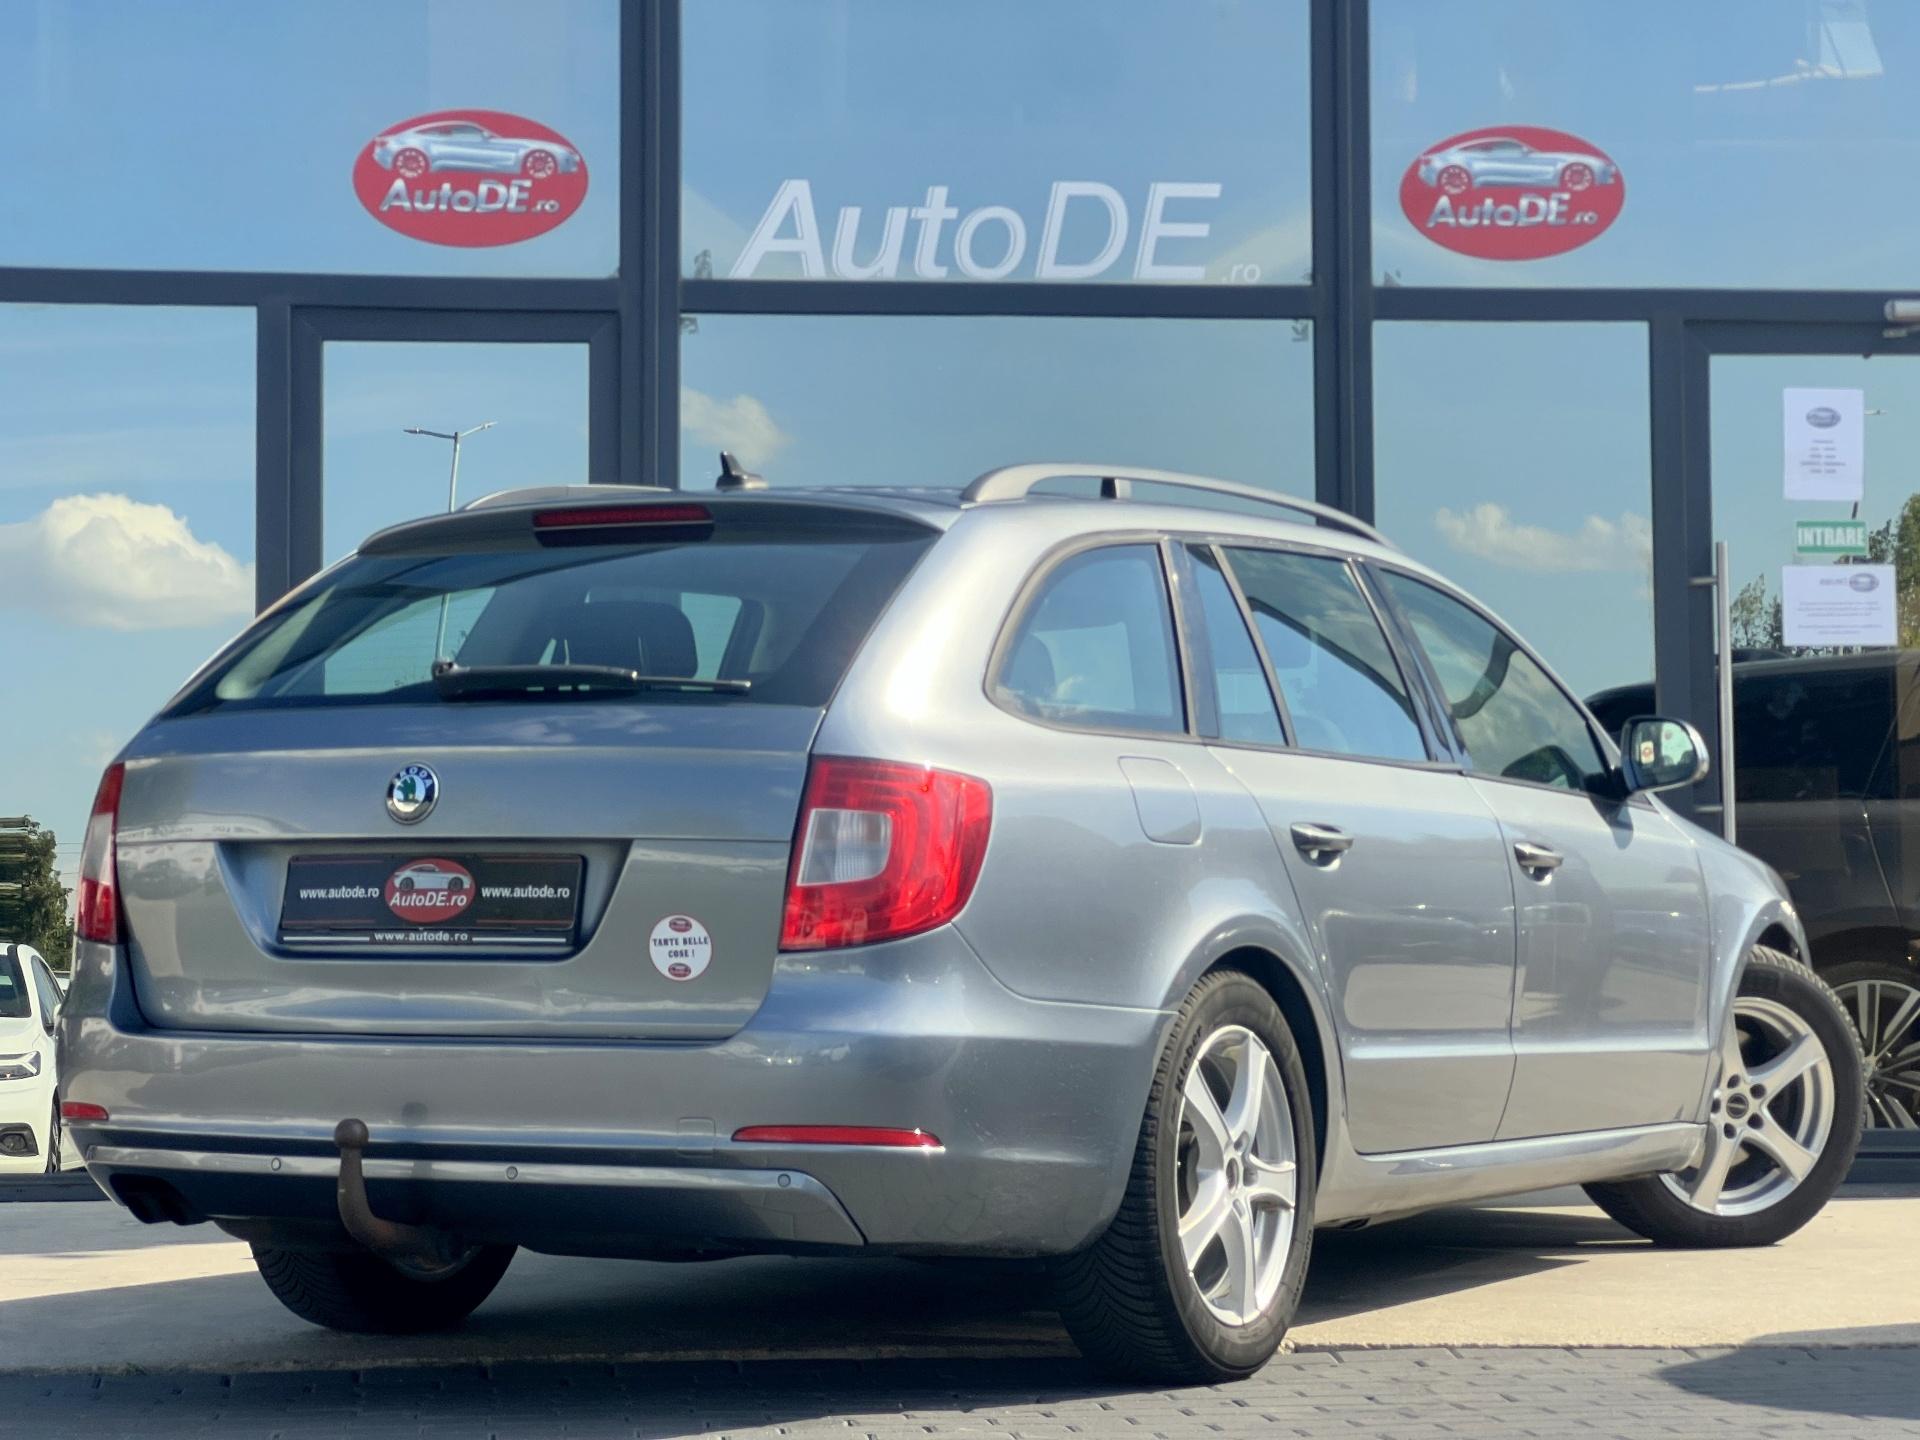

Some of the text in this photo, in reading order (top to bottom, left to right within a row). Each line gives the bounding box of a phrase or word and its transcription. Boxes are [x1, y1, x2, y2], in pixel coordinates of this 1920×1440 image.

[728, 178, 1222, 281] AutoDE
[1798, 526, 1866, 547] INTRARE
[300, 885, 380, 899] www.autode.ro
[481, 884, 571, 898] www.autode.ro
[390, 891, 467, 906] AutoDE.ro
[374, 930, 468, 941] www.autode.ro
